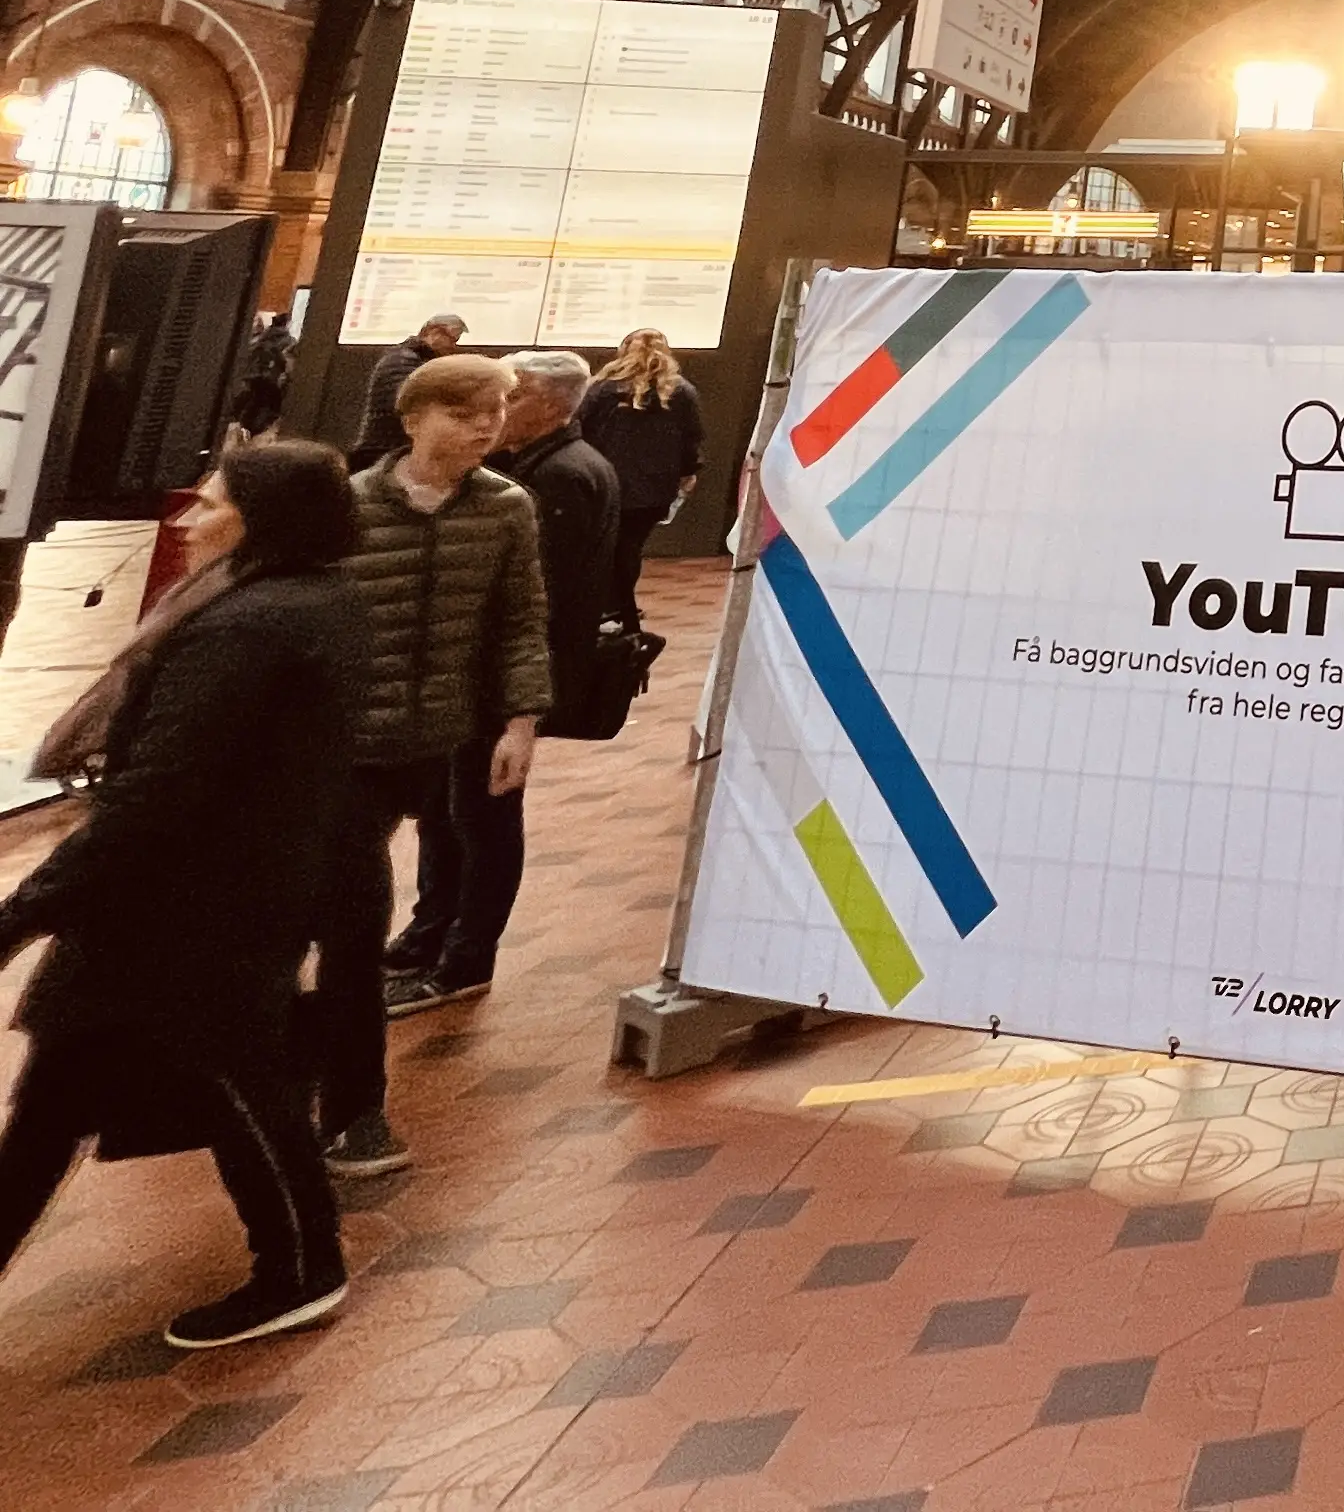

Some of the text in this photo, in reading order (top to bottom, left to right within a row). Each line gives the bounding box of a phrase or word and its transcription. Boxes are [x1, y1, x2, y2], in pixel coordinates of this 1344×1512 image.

[1013, 635, 1041, 662] Få
[1050, 640, 1266, 679] baggrundsviden
[1276, 660, 1310, 687] og
[1187, 688, 1223, 715] fra
[1233, 692, 1291, 720] hele
[1253, 990, 1341, 1019] LORRY
